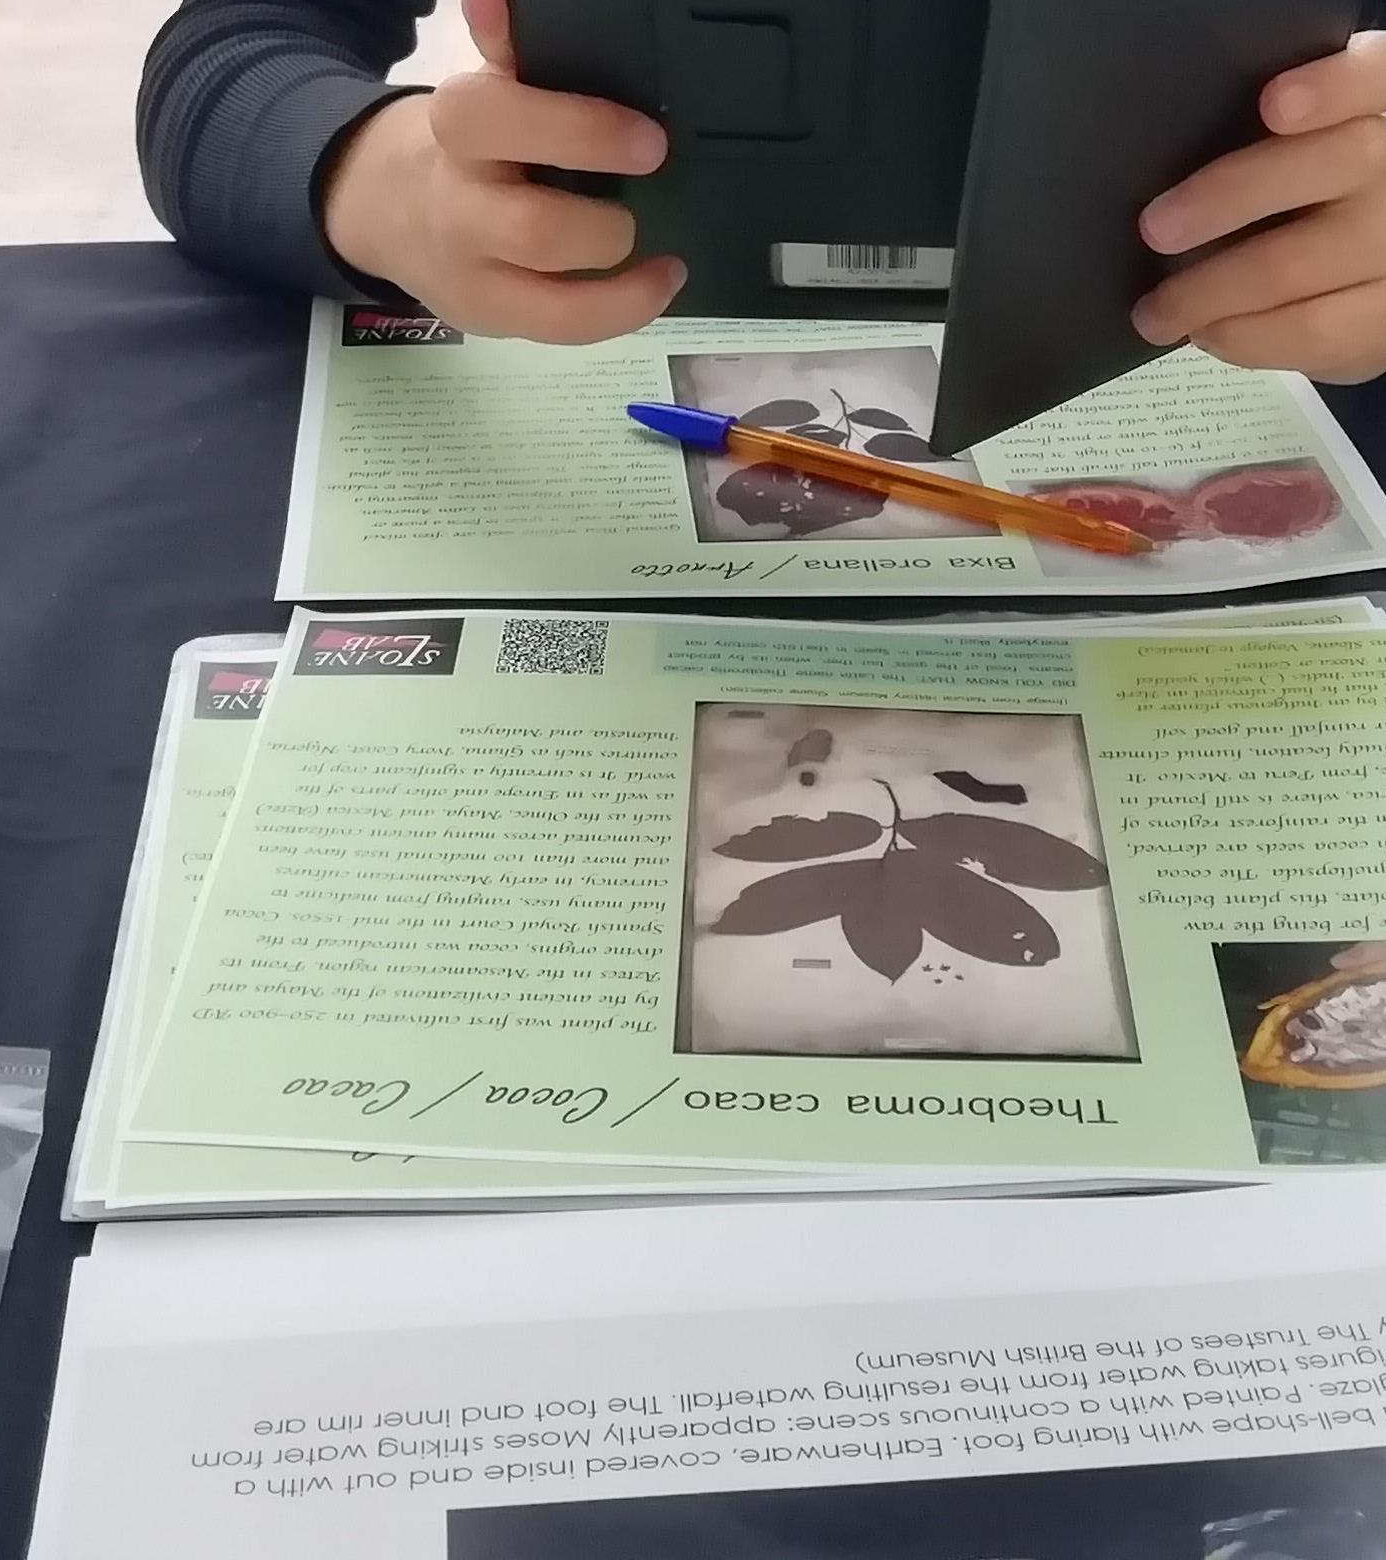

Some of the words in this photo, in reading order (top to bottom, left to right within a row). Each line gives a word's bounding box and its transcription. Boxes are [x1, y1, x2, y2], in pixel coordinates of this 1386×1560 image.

[631, 562, 754, 579] Arnotto
[804, 559, 931, 572] orellana
[949, 557, 1015, 569] Bixa
[1157, 869, 1211, 878] cocoa
[1220, 869, 1258, 882] The
[1139, 890, 1214, 908] belongs
[1226, 891, 1280, 907] plant
[1290, 894, 1327, 907] this
[1184, 922, 1223, 930] raw
[1234, 922, 1264, 934] the
[1274, 916, 1330, 933] being
[1341, 916, 1369, 932] for
[221, 958, 242, 967] its
[251, 960, 305, 972] From
[315, 958, 377, 972] region.
[387, 965, 529, 978] Mesoamerican
[537, 969, 564, 980] the
[574, 970, 591, 978] in
[601, 971, 660, 982] Aztecs
[207, 983, 247, 994] and
[255, 982, 324, 997] Mayas
[333, 988, 360, 999] the
[368, 986, 386, 1000] of
[393, 990, 510, 1002] civilizations
[518, 993, 591, 1002] ancient
[598, 995, 626, 1006] the
[635, 992, 658, 1008] by
[193, 1008, 231, 1019] AD
[336, 1013, 354, 1022] in
[363, 1014, 460, 1028] cultivated
[469, 1014, 508, 1030] first
[517, 1018, 551, 1026] was
[562, 1017, 613, 1031] plant
[621, 1021, 657, 1032] The
[283, 1078, 410, 1115] Cacao
[486, 1086, 608, 1123] Cocoa
[685, 1091, 819, 1112] cacao
[848, 1096, 1118, 1124] Theobroma
[1191, 1329, 1310, 1349] Trustees
[1317, 1323, 1371, 1341] The
[1005, 1345, 1087, 1365] British
[1096, 1341, 1145, 1357] the
[1156, 1338, 1182, 1357] of
[856, 1350, 996, 1373] Museum)
[1194, 1358, 1287, 1378] taking
[1019, 1372, 1087, 1389] from
[1099, 1365, 1185, 1386] water
[824, 1380, 949, 1402] resulting
[961, 1377, 1009, 1395] the
[608, 1396, 662, 1415] The
[673, 1388, 814, 1412] waterfall.
[1110, 1395, 1173, 1415] with
[1183, 1385, 1301, 1410] Painted
[535, 1400, 596, 1422] foot
[900, 1402, 1069, 1424] continuous
[1080, 1400, 1100, 1413] a
[318, 1415, 362, 1431] rim
[374, 1409, 449, 1428] inner
[462, 1405, 524, 1427] and
[788, 1412, 890, 1431] scene:
[1213, 1408, 1375, 1432] bell-shape
[254, 1419, 306, 1435] are
[604, 1415, 775, 1446] apparently
[1139, 1421, 1203, 1442] with
[494, 1429, 590, 1449] Moses
[953, 1433, 1024, 1454] foot.
[1034, 1426, 1129, 1447] flaring
[273, 1444, 367, 1466] water
[378, 1437, 483, 1459] striking
[733, 1438, 942, 1463] Earthenware,
[192, 1451, 262, 1469] from
[586, 1451, 720, 1477] covered
[410, 1468, 472, 1490] and
[485, 1460, 573, 1483] inside
[235, 1480, 255, 1495] a
[268, 1477, 332, 1497] with
[345, 1473, 396, 1494] out
